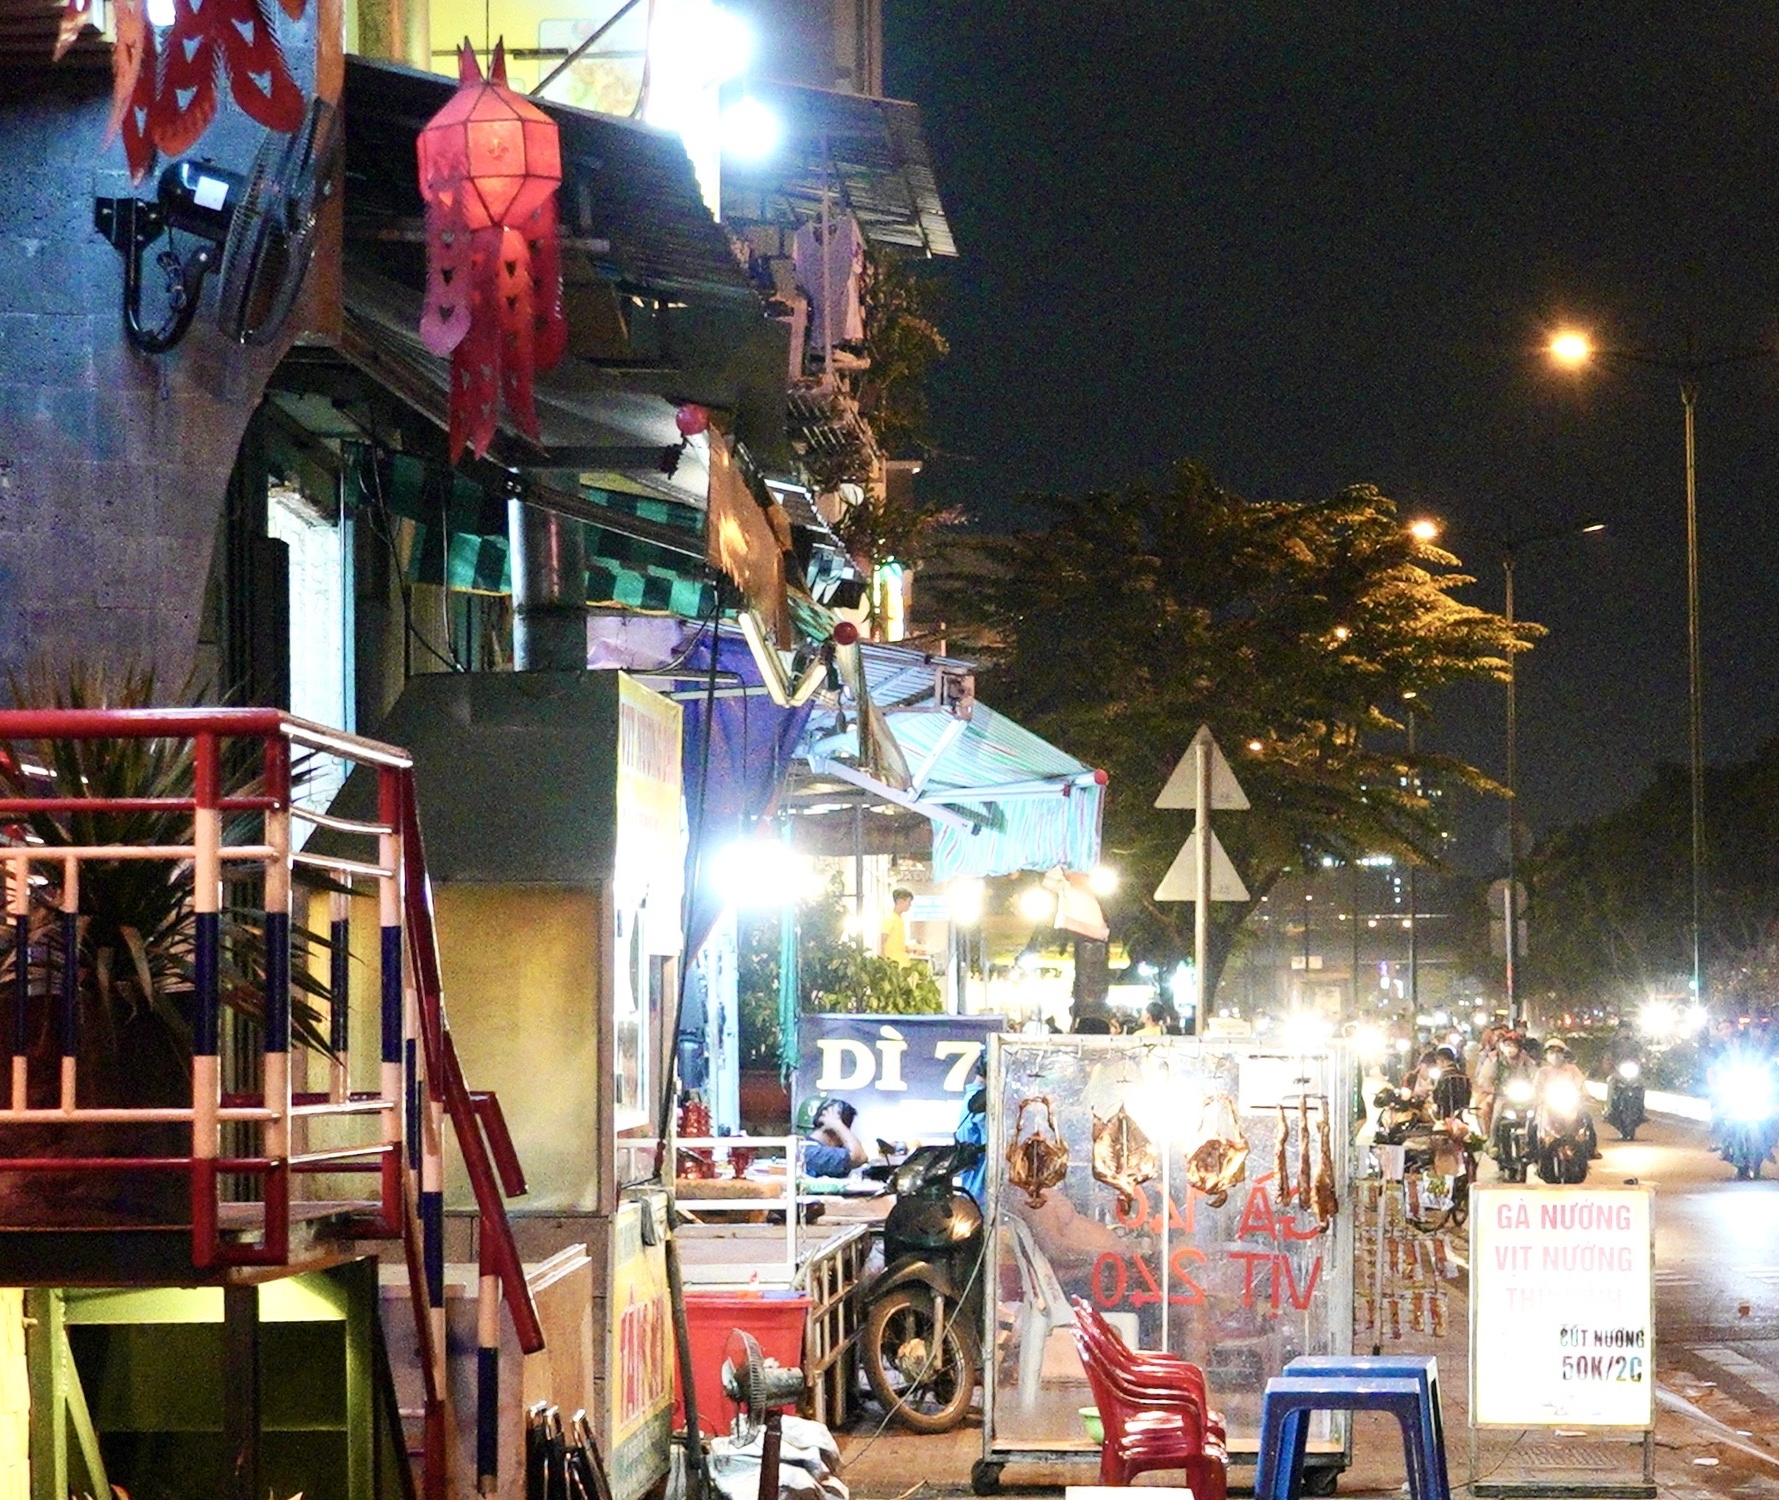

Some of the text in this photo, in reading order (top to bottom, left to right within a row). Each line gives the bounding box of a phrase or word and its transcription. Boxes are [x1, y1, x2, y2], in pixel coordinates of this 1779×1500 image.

[816, 1025, 982, 1092] DÌ 7
[1497, 1198, 1631, 1231] GÀ NƯỚNG
[1494, 1241, 1633, 1276] VỊT NƯỚNG
